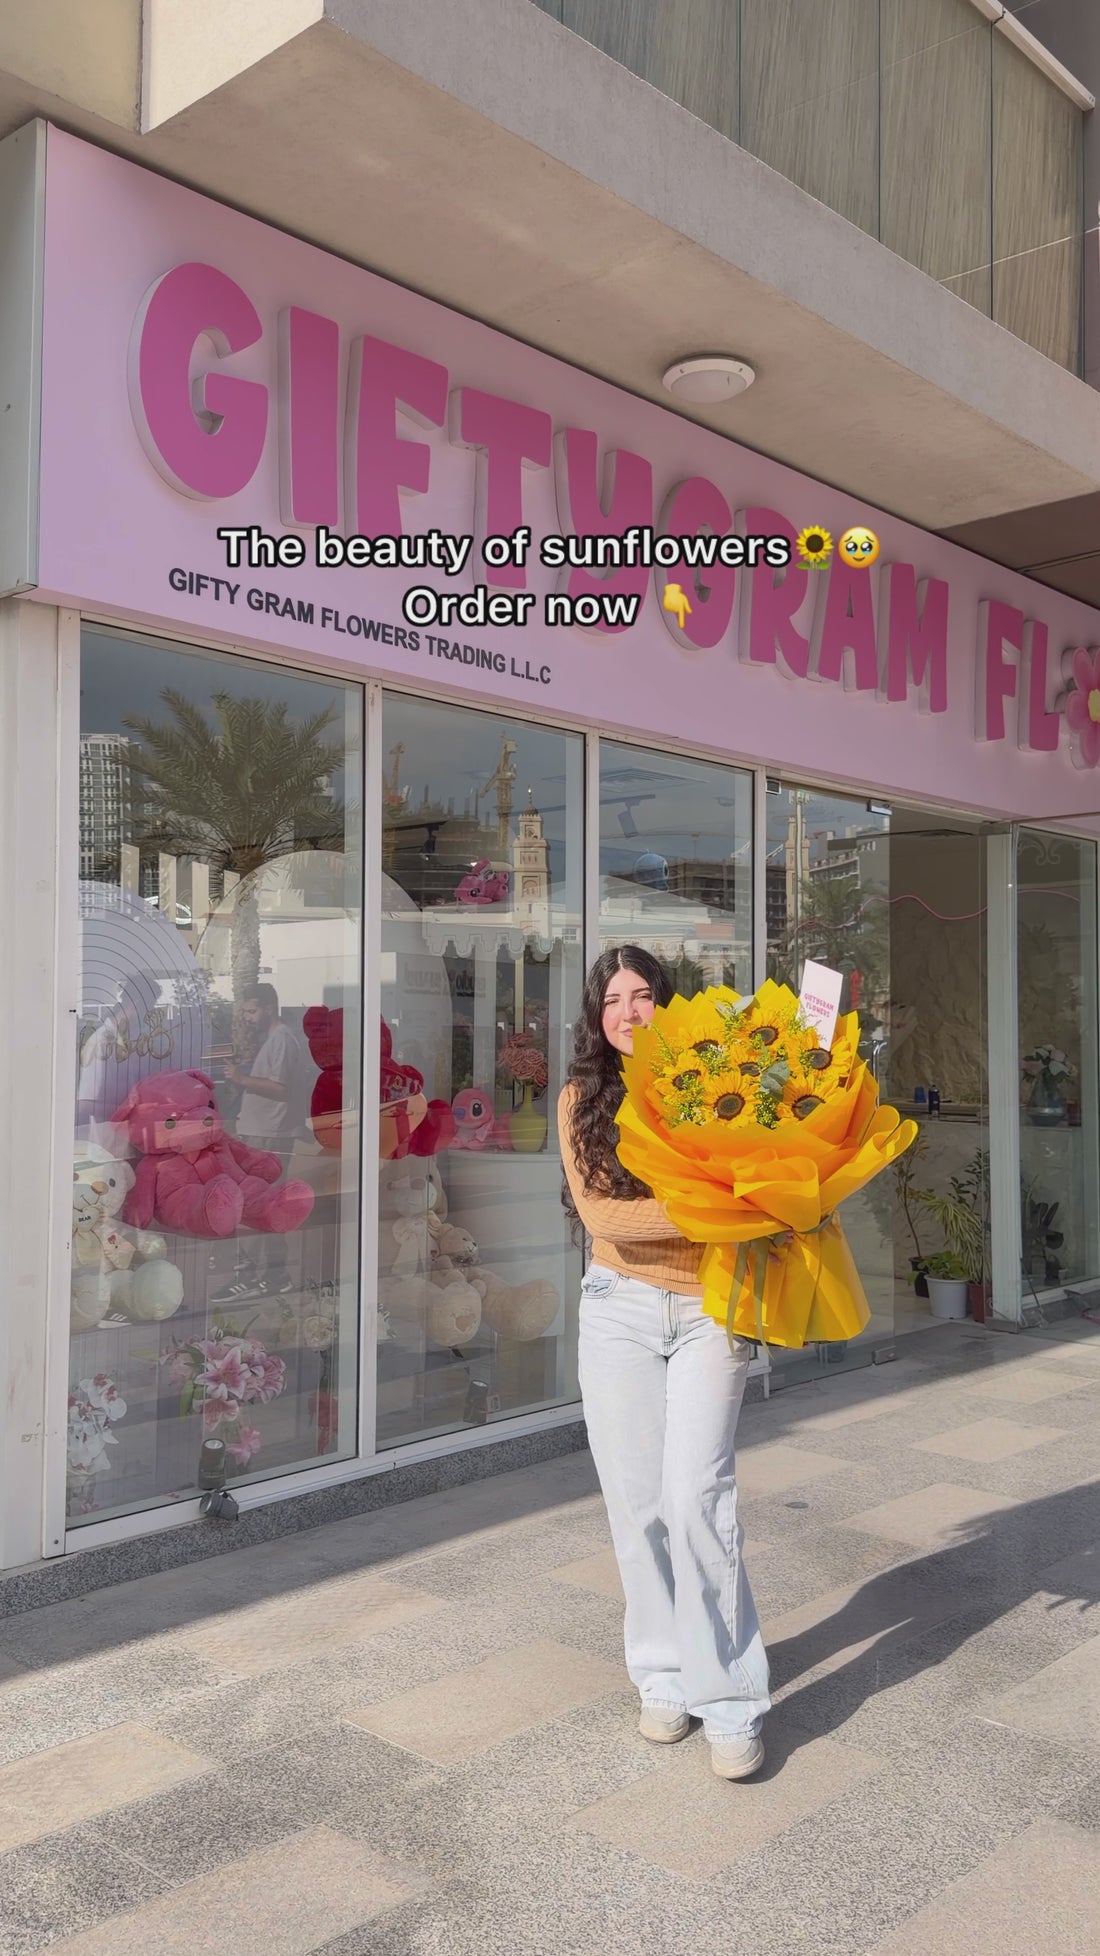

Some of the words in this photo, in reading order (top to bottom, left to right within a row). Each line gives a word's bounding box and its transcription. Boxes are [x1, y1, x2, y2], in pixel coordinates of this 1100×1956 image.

[127, 262, 949, 714] GIFTYGRAM
[168, 567, 241, 605] GIFTY
[246, 588, 315, 625] GRAM
[320, 606, 420, 653] FLOWERS
[424, 635, 507, 673] TRADING
[510, 652, 551, 685] L.L.C
